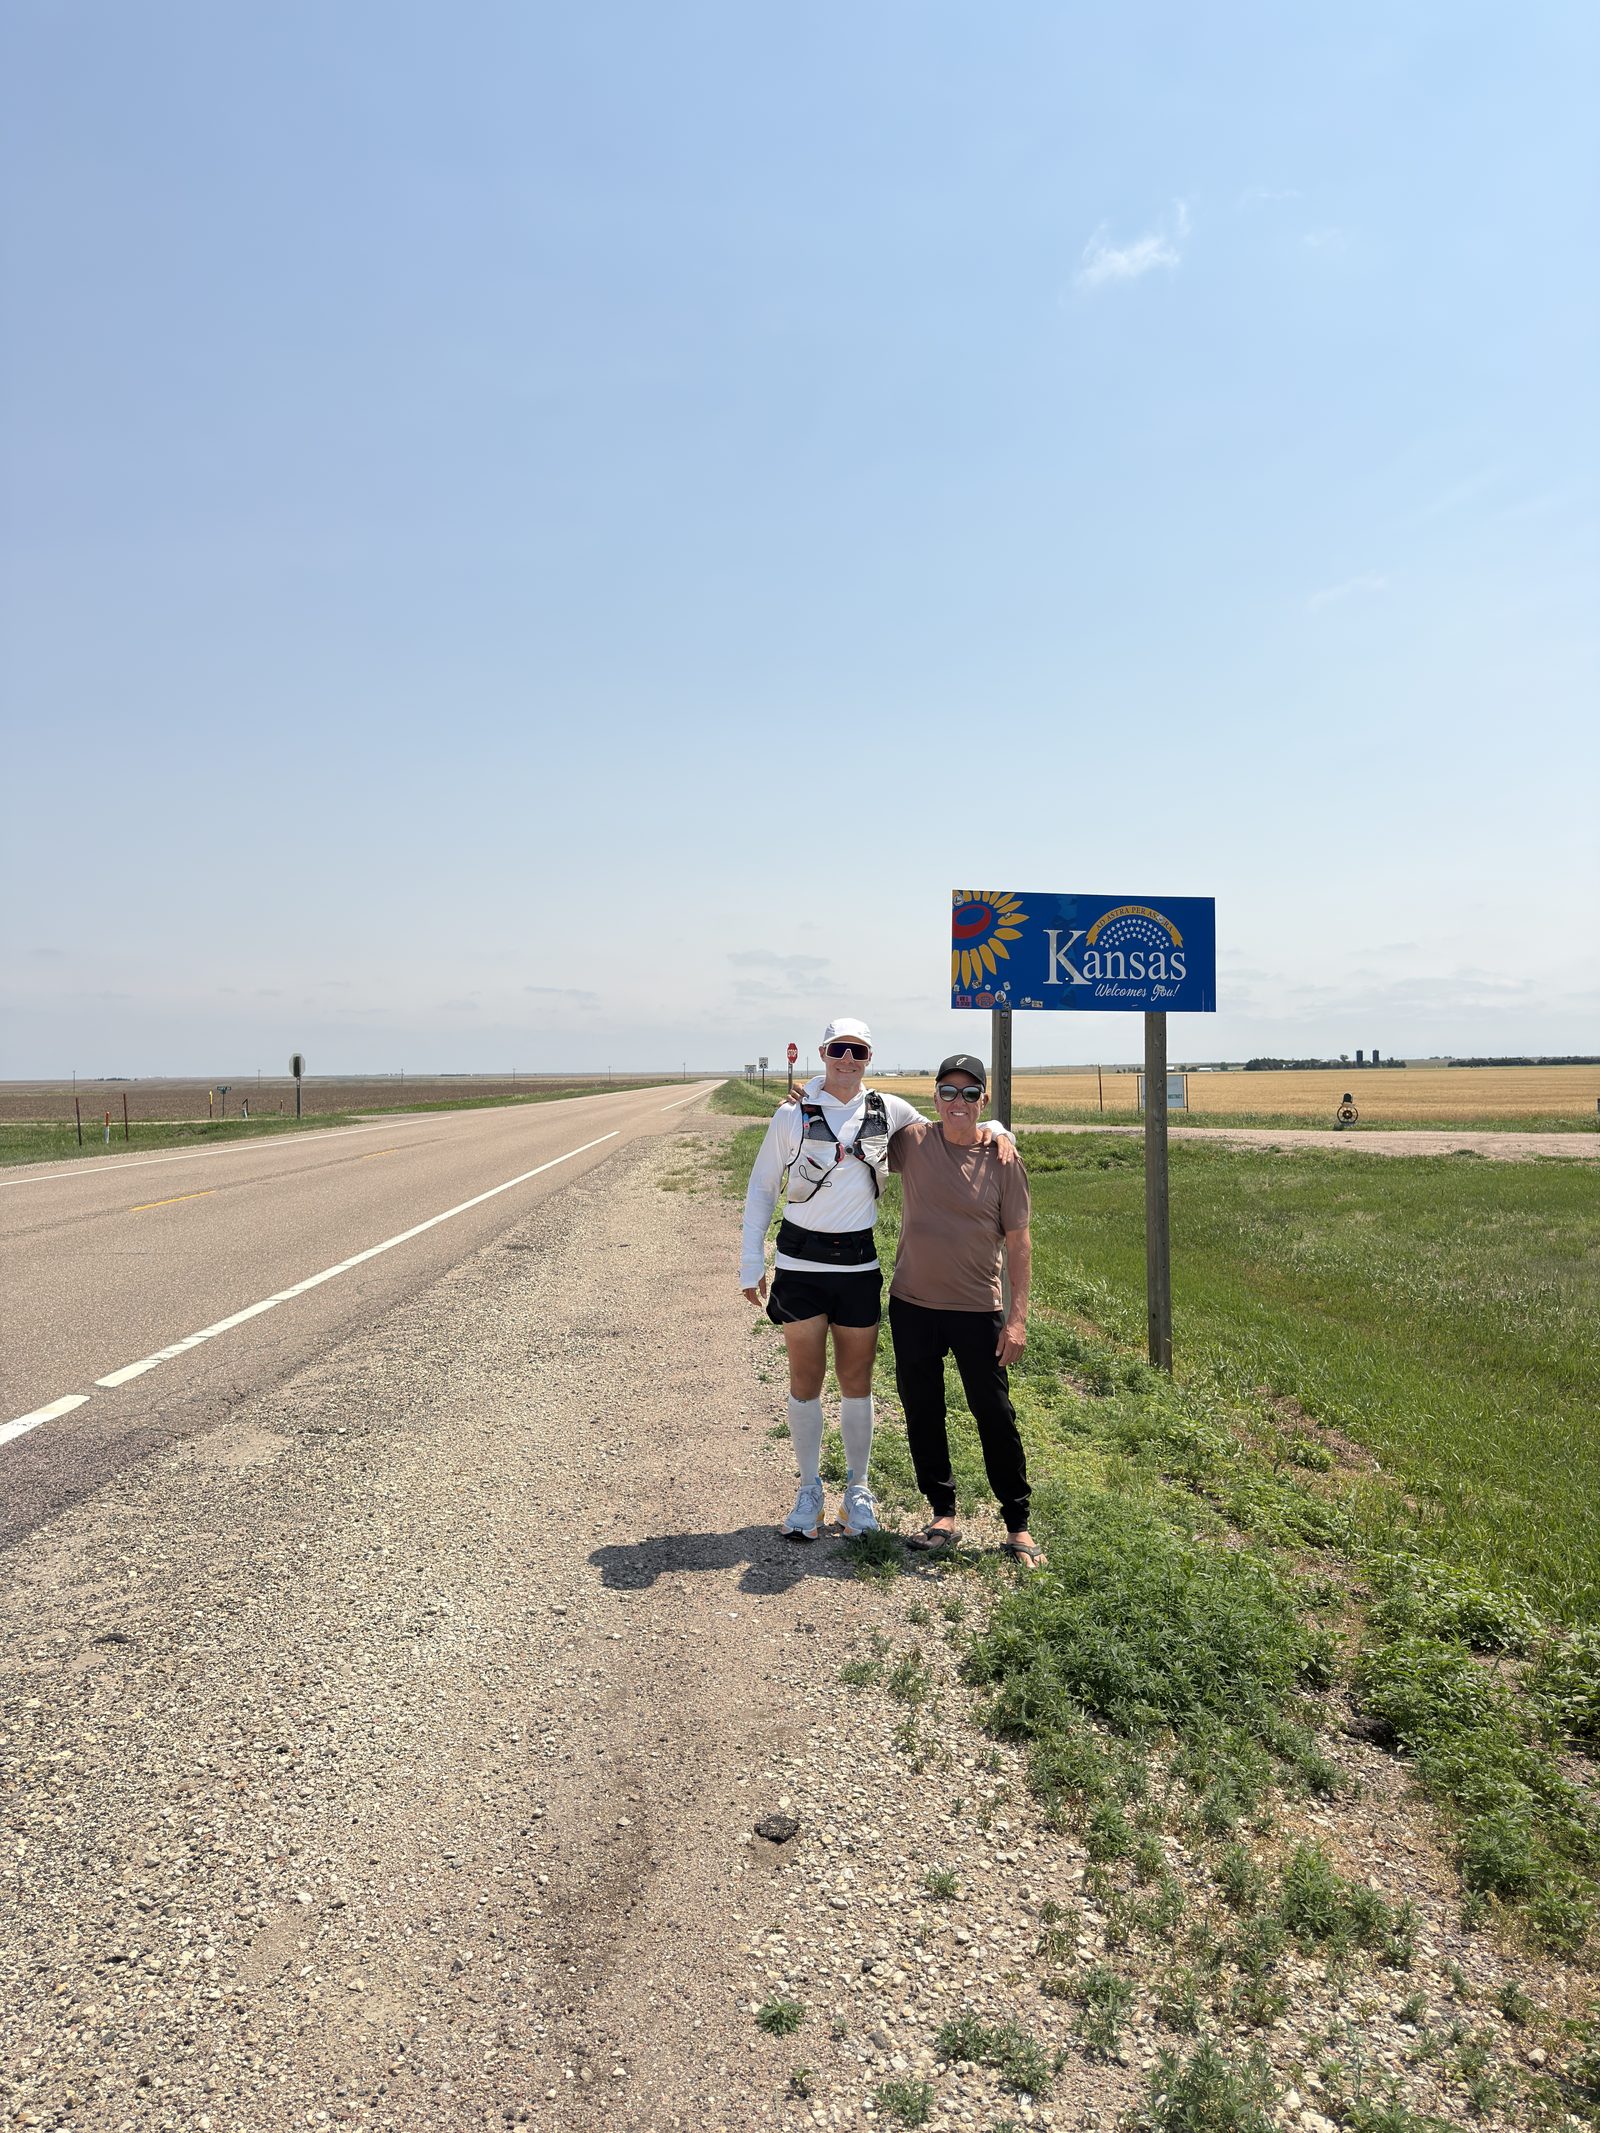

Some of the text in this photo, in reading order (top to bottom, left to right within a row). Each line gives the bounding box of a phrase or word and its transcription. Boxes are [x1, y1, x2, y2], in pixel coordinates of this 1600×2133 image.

[1096, 906, 1173, 932] AD ASTRA PER ASRA
[1043, 929, 1187, 985] Kansas
[1094, 982, 1147, 998] Welcomes
[788, 1049, 798, 1057] STOP
